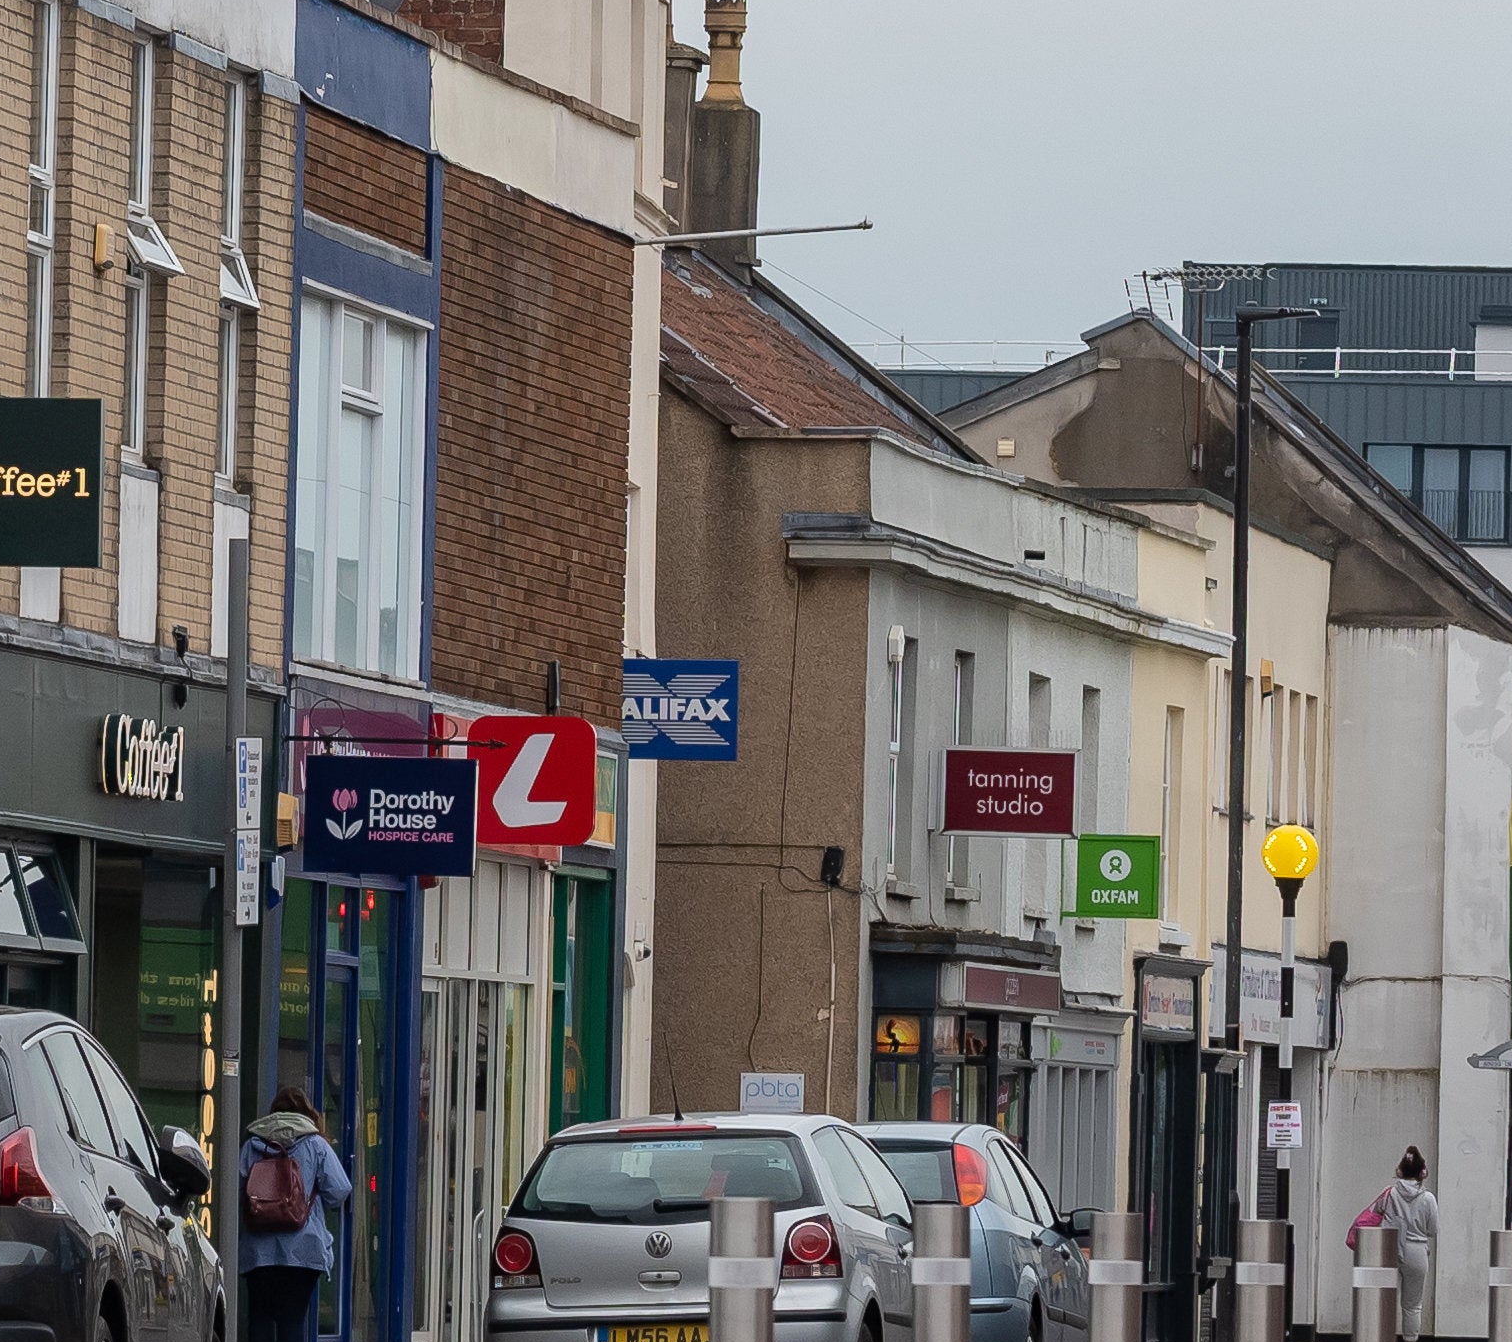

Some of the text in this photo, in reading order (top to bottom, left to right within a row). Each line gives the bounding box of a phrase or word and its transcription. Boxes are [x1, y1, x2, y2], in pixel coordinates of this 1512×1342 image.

[622, 697, 731, 722] ALIFAX
[967, 767, 1054, 794] tanning
[370, 789, 455, 814] Dorothy
[976, 795, 1044, 817] studio
[369, 809, 437, 830] House
[368, 831, 454, 843] HOSPICE CARE
[1091, 889, 1139, 906] OXFAM
[746, 1077, 800, 1102] pbta
